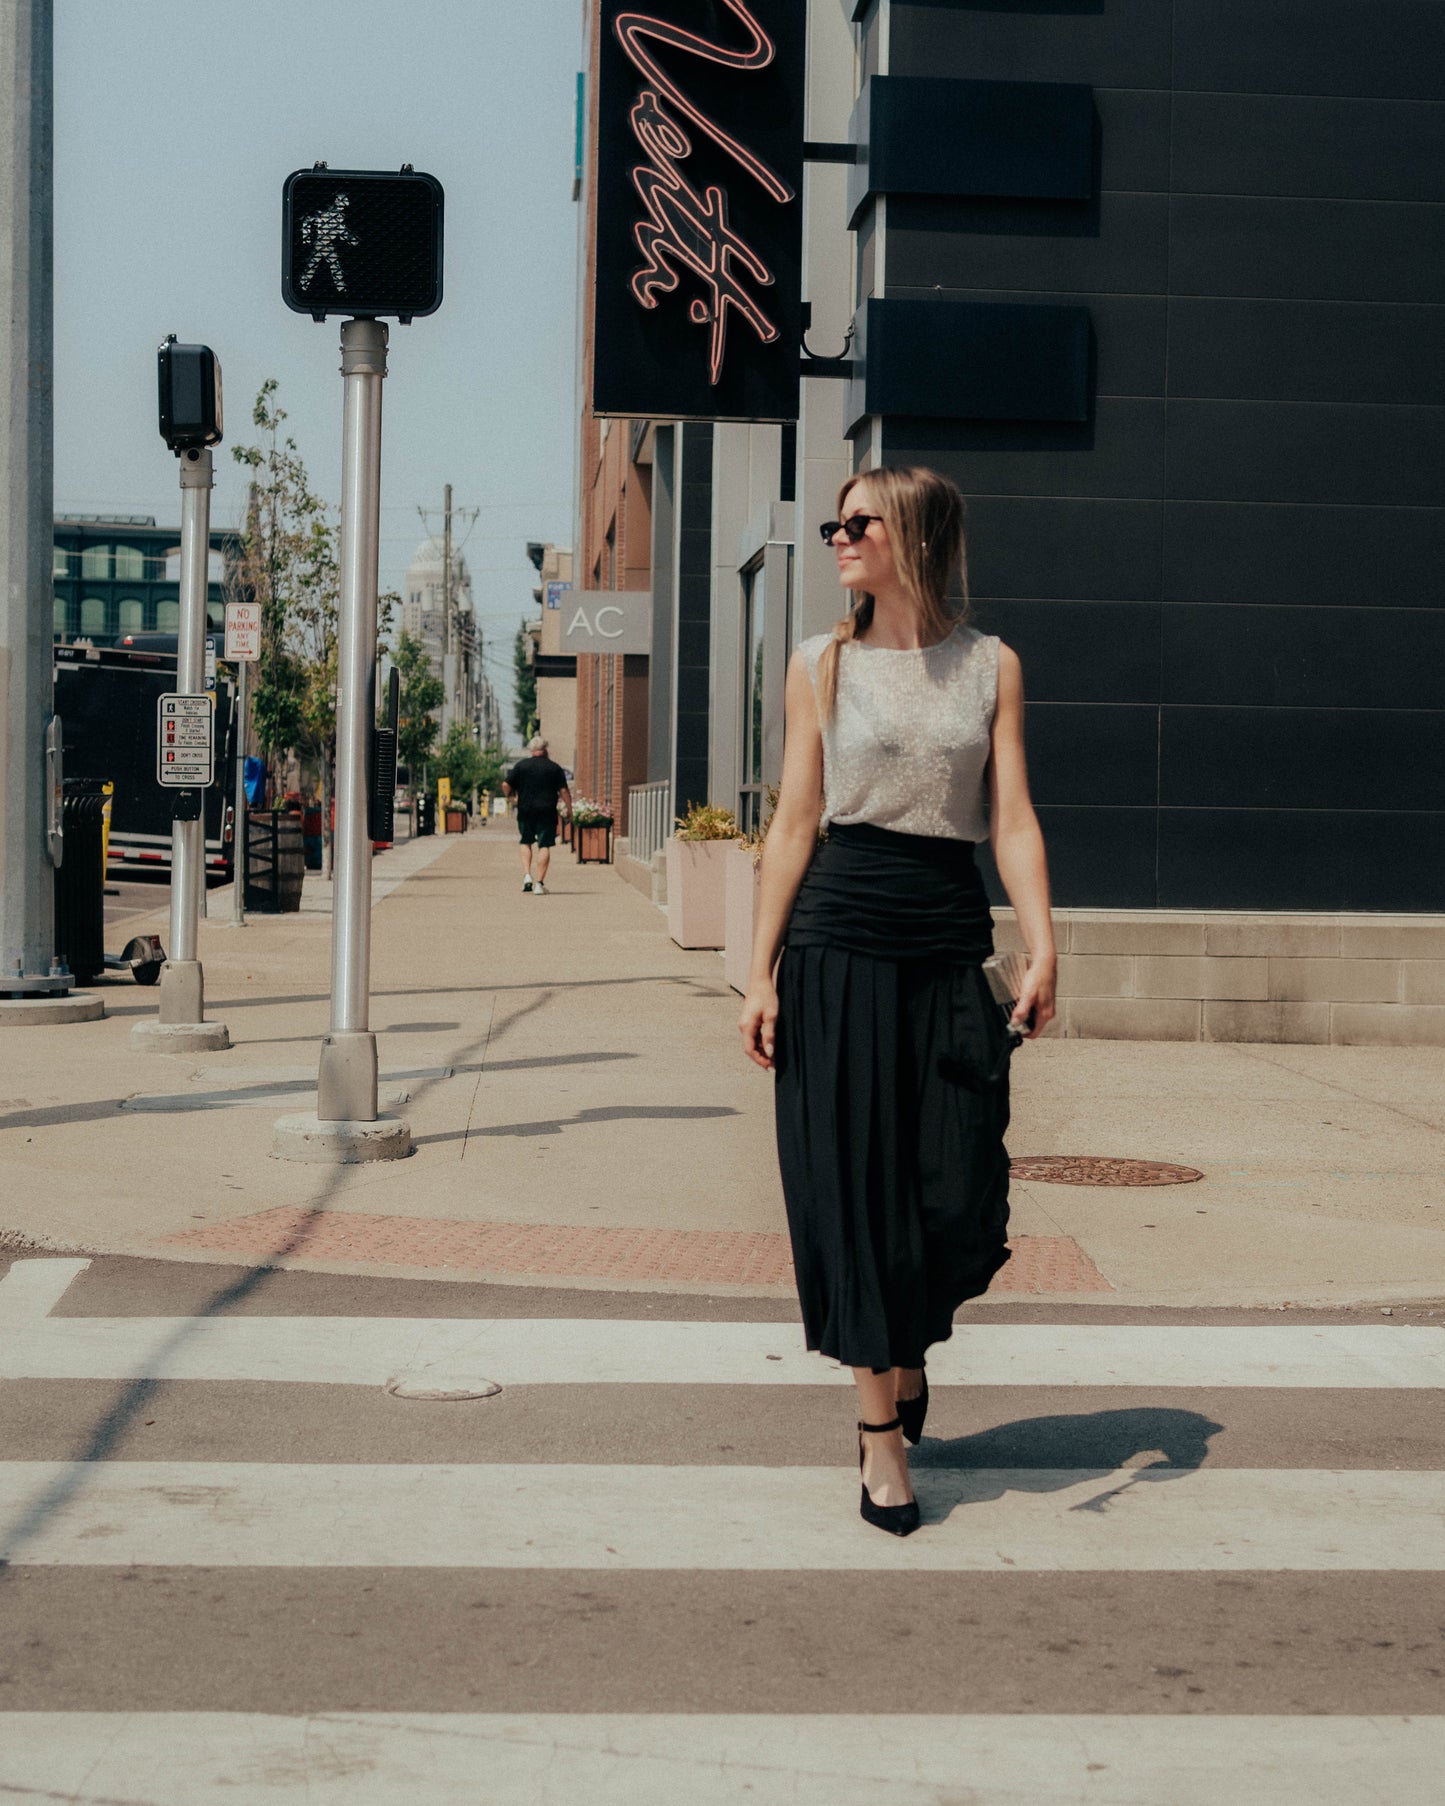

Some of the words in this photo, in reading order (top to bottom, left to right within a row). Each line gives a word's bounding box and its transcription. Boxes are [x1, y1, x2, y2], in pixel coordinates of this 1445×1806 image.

[237, 608, 249, 619] NO
[228, 621, 258, 631] PARKING
[566, 606, 624, 638] AC
